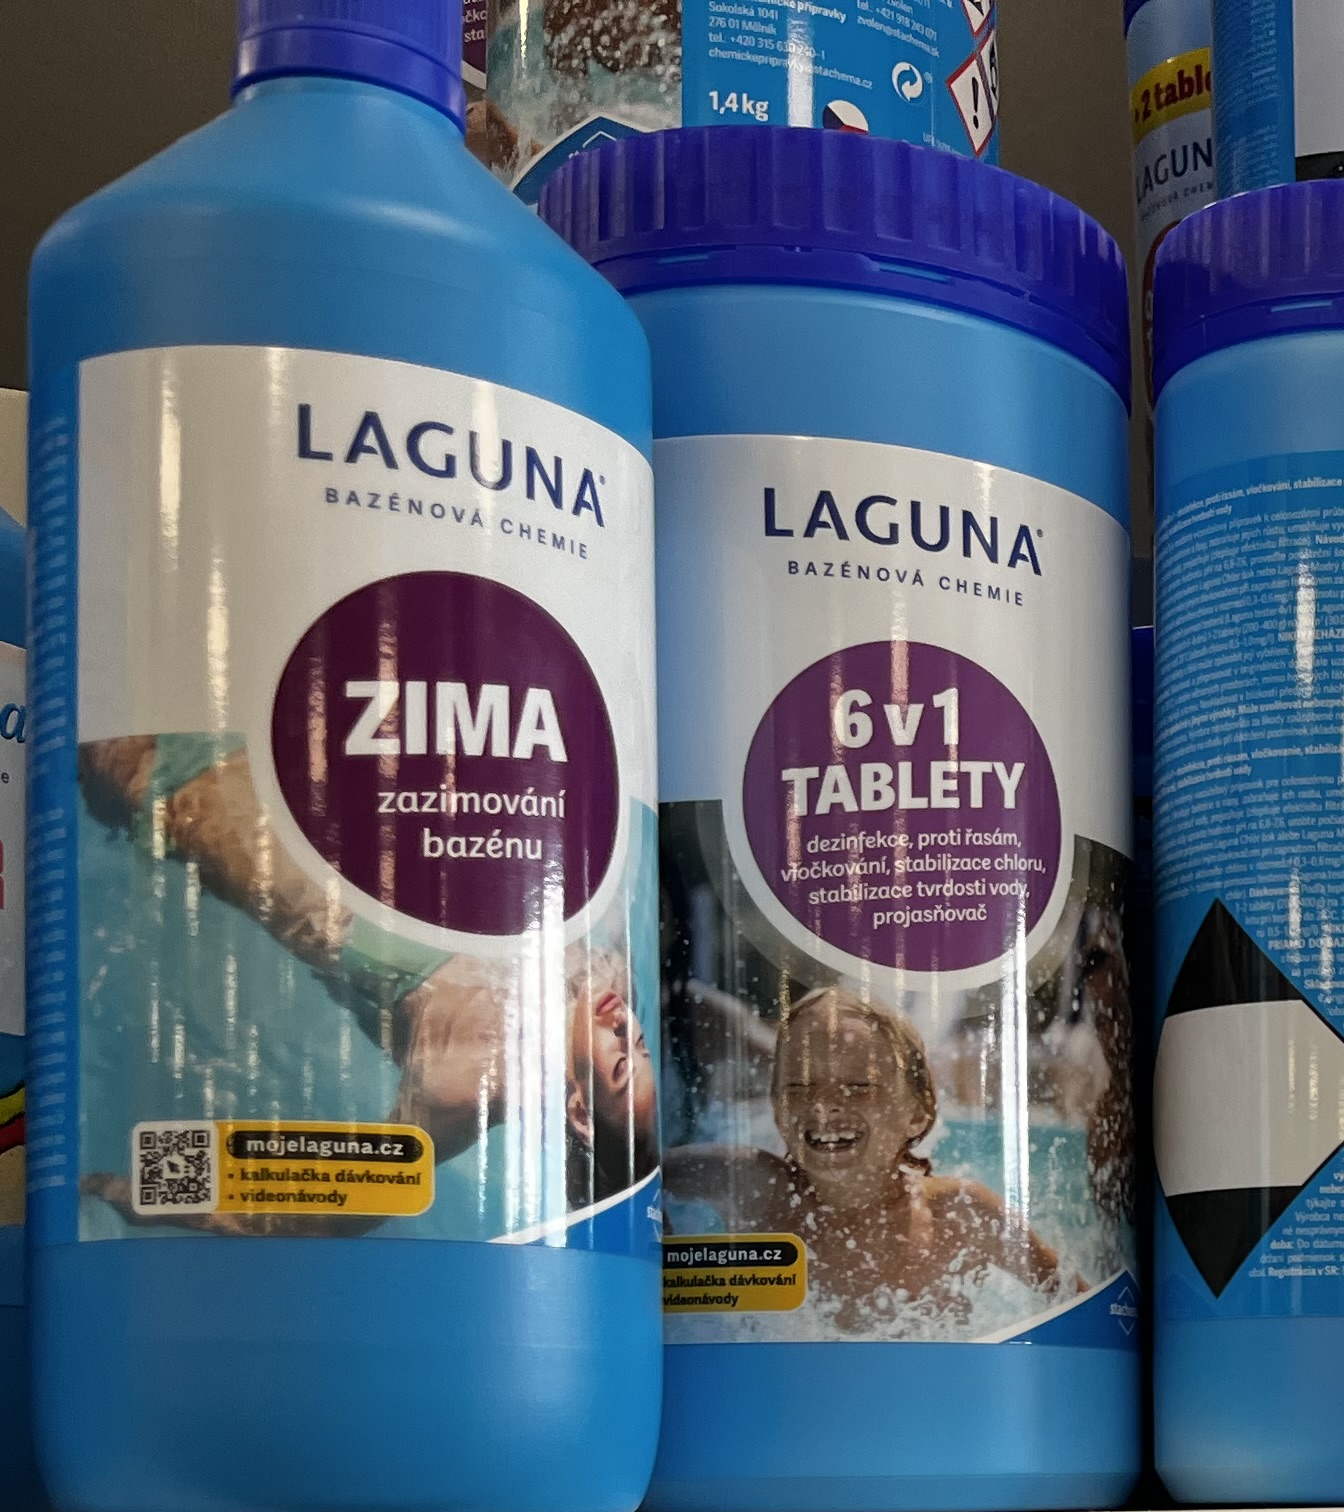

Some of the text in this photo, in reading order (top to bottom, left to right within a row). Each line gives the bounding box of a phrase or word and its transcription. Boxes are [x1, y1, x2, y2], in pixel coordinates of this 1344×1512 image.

[742, 92, 769, 121] kg
[297, 403, 606, 528] LAGUNA
[500, 518, 589, 559] CHEMIE
[763, 487, 1043, 577] LAGUNA
[787, 560, 1025, 607] BAZÉNOVÁ CHEMIE
[344, 680, 568, 763] ZIMA
[377, 784, 567, 819] zazimování
[781, 760, 1026, 817] TABLETY
[422, 827, 544, 861] bazénu
[806, 827, 913, 855] dezinfekce,
[894, 852, 992, 875] stabilizace
[873, 903, 987, 929] projasňovač
[245, 1134, 404, 1158] mojelaguna.cz
[334, 1166, 422, 1188] dávkování
[239, 1188, 348, 1207] videonávody
[666, 1245, 782, 1265] mojelaguna.cz
